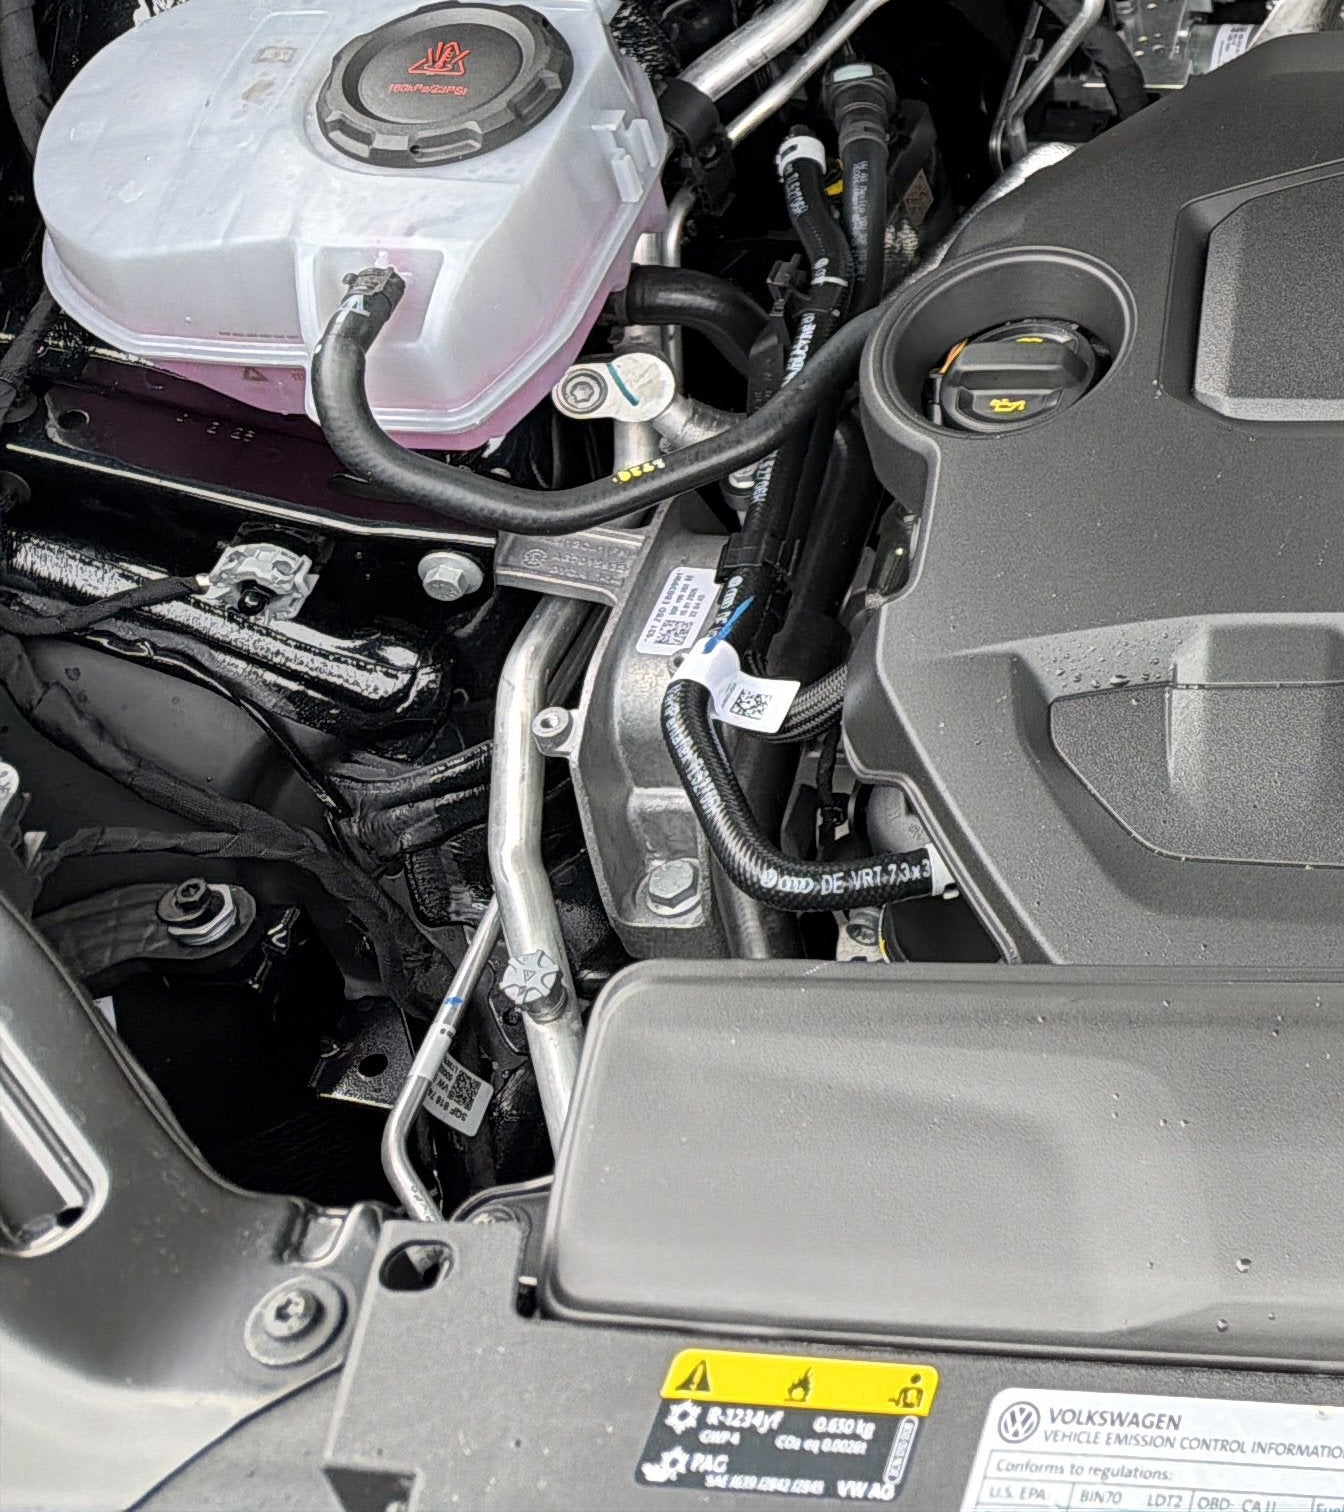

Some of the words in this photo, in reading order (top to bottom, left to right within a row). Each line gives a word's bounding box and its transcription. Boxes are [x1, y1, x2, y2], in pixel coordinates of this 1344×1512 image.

[705, 1406, 785, 1434] R-1234yf
[855, 1420, 876, 1440] kg
[1049, 1407, 1183, 1431] VOLKSWAGEN
[1043, 1429, 1101, 1446] VEHICLE
[1105, 1431, 1177, 1450] EMISSION
[1180, 1437, 1247, 1454] CONTROL
[690, 1452, 729, 1474] PAG
[996, 1458, 1065, 1475] Conforms
[1069, 1461, 1085, 1476] to
[1088, 1464, 1173, 1482] regulations:
[836, 1479, 867, 1499] VW
[867, 1482, 897, 1501] AG
[1019, 1487, 1046, 1501] EPA
[1146, 1493, 1183, 1508] LDT2
